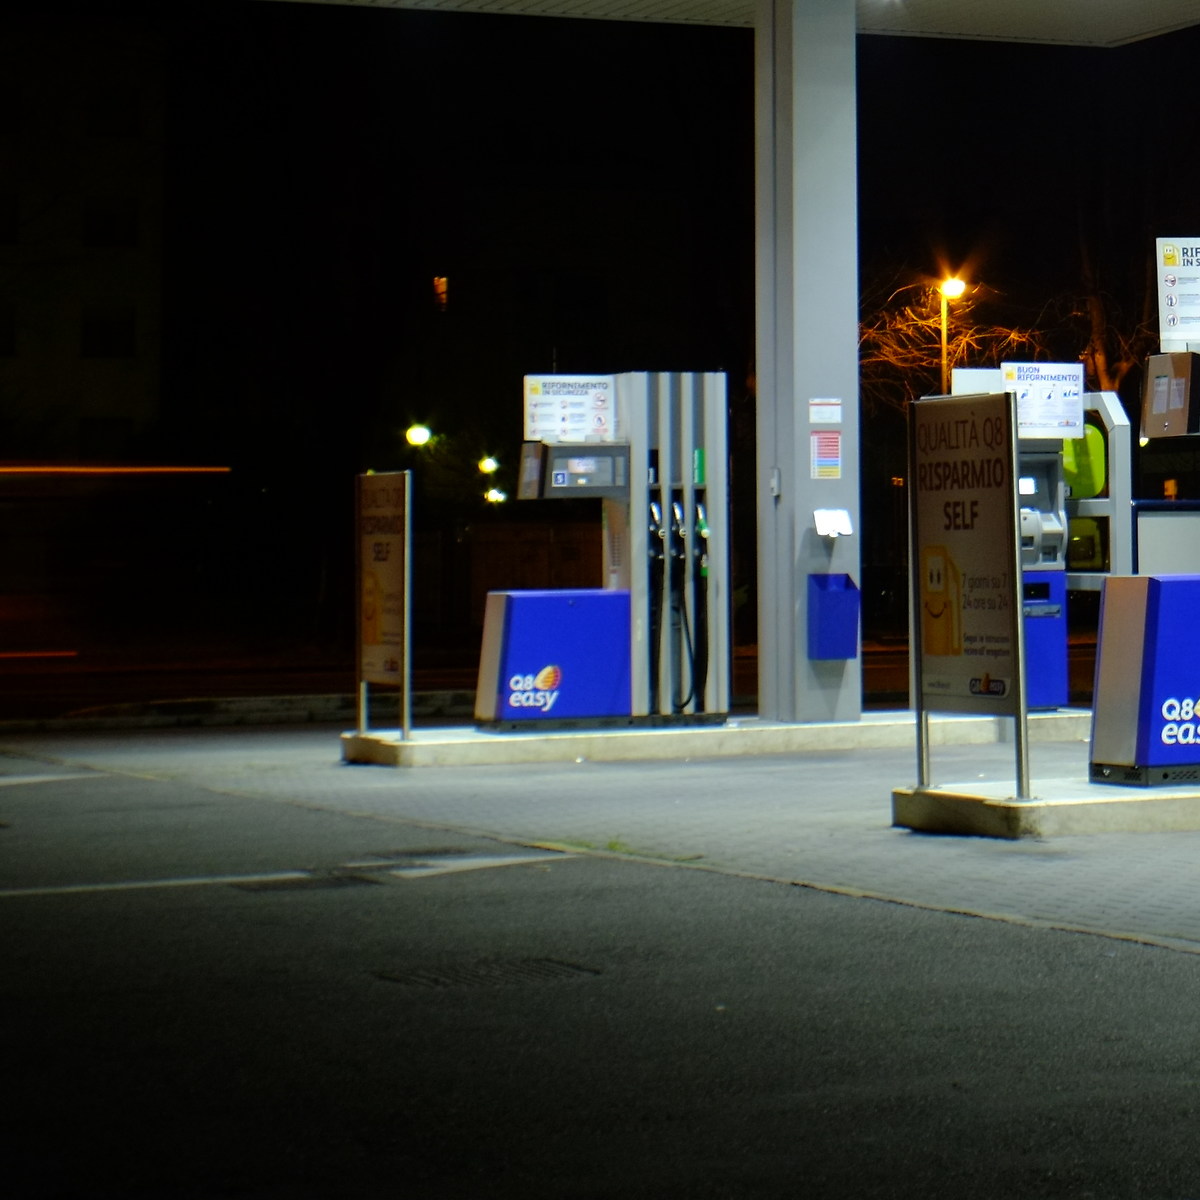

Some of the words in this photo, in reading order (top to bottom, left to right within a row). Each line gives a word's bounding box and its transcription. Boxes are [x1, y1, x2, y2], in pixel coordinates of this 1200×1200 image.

[1182, 258, 1193, 267] IN
[1017, 366, 1040, 374] BUON
[1017, 373, 1080, 382] RIFORNIMENTO!
[542, 382, 609, 390] RIFORNIMENTO
[918, 410, 980, 456] QUALITÀ
[982, 416, 1004, 451] Q8
[918, 457, 1005, 492] RISPARMIO
[943, 500, 979, 531] SELF
[962, 573, 967, 589] 7
[509, 674, 534, 691] Q8
[508, 690, 560, 712] easy
[1161, 697, 1194, 721] Q8
